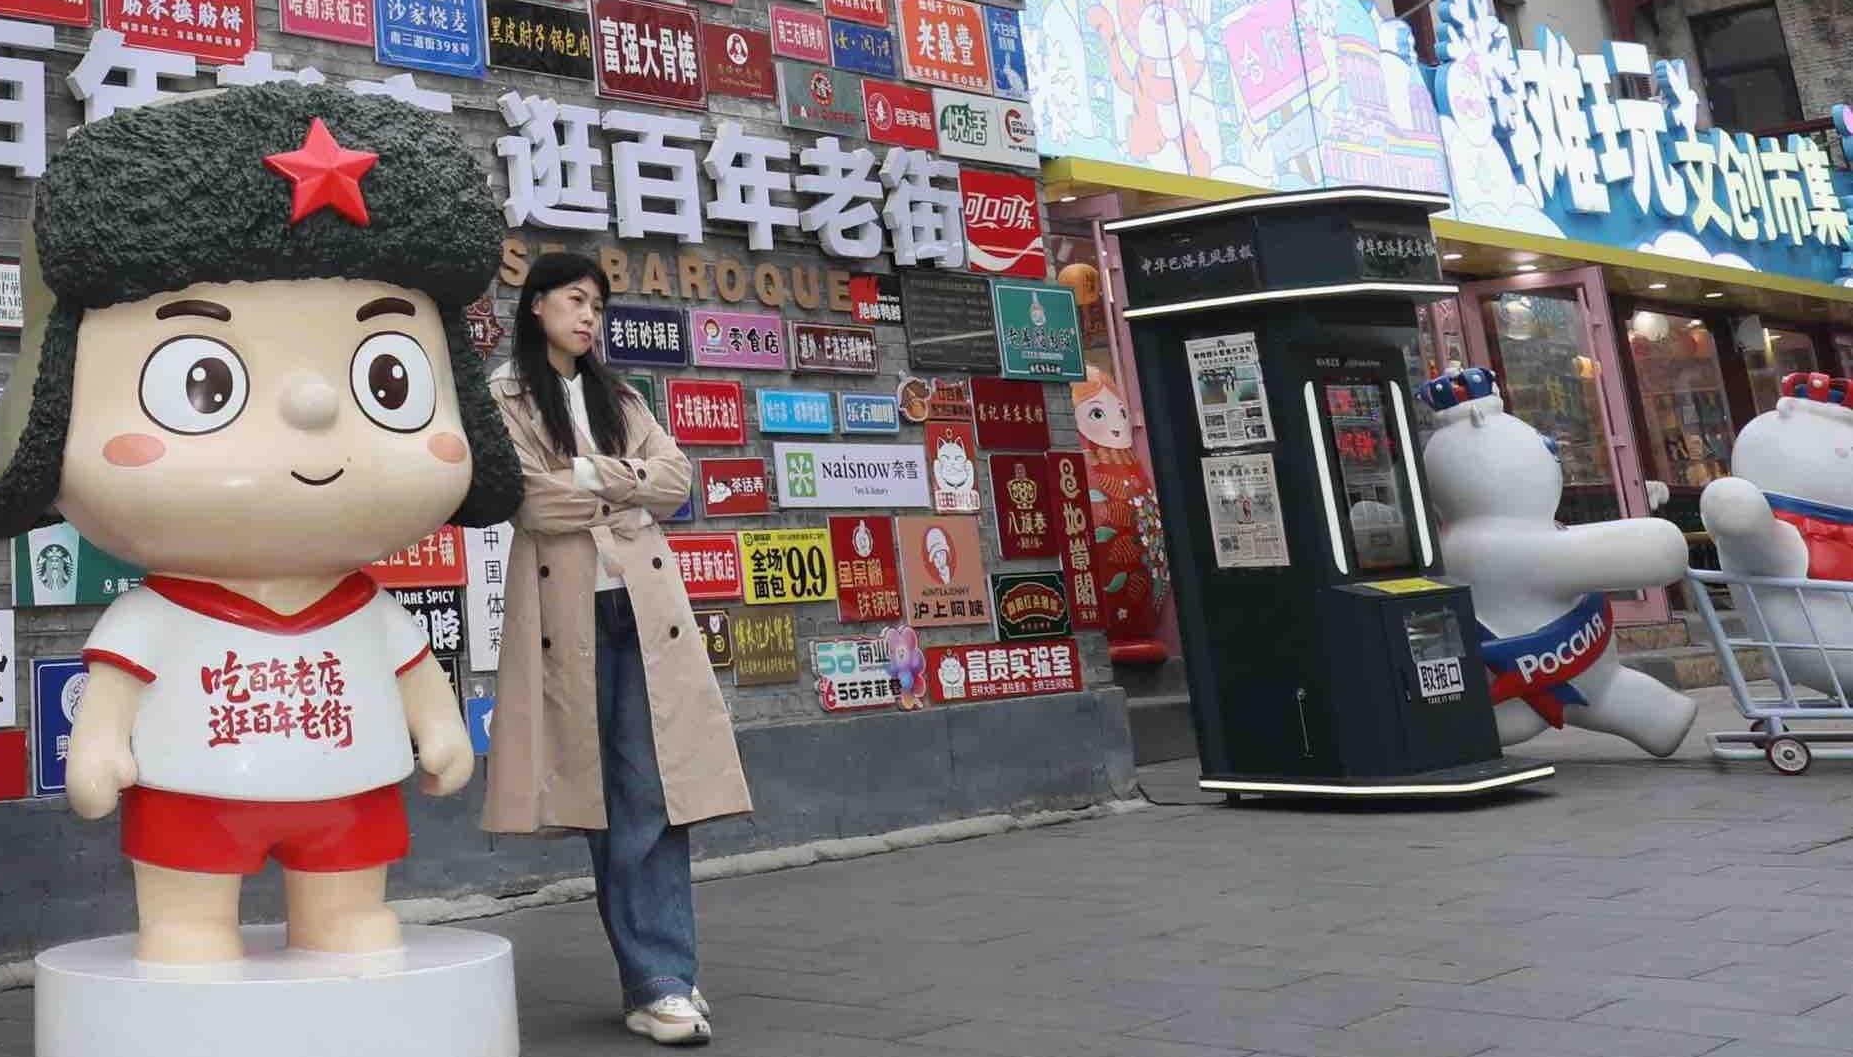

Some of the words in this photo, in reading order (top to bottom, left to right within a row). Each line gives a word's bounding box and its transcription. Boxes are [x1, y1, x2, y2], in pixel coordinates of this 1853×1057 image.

[948, 5, 964, 16] 1911
[490, 15, 545, 51] 黑皮肘子
[549, 30, 590, 58] 锅包肉
[599, 16, 697, 86] 富强大骨棒
[948, 105, 987, 145] 悦活
[497, 91, 965, 267] 逛百年老街
[1676, 128, 1849, 246] 文创市集
[965, 192, 1035, 230] 可口可乐
[600, 246, 851, 312] BAROQUE
[611, 317, 680, 352] 老街砂锅居
[728, 327, 779, 355] 零食店
[731, 477, 764, 493] 茶话弄
[822, 455, 890, 480] Naisnow
[893, 460, 918, 480] 奈雪
[372, 532, 455, 566] 包子铺
[674, 551, 735, 582] 营更新饭店
[751, 549, 783, 573] 全场
[427, 589, 455, 604] SPICY
[753, 575, 786, 599] 面包
[914, 600, 984, 619] 沪上阿姨
[966, 646, 1071, 682] 富贵实验室
[1515, 612, 1607, 684] РОССИЯ
[201, 650, 347, 704] 吃百年老店
[1420, 664, 1461, 689] 取报口
[208, 701, 354, 749] 逛百年老街
